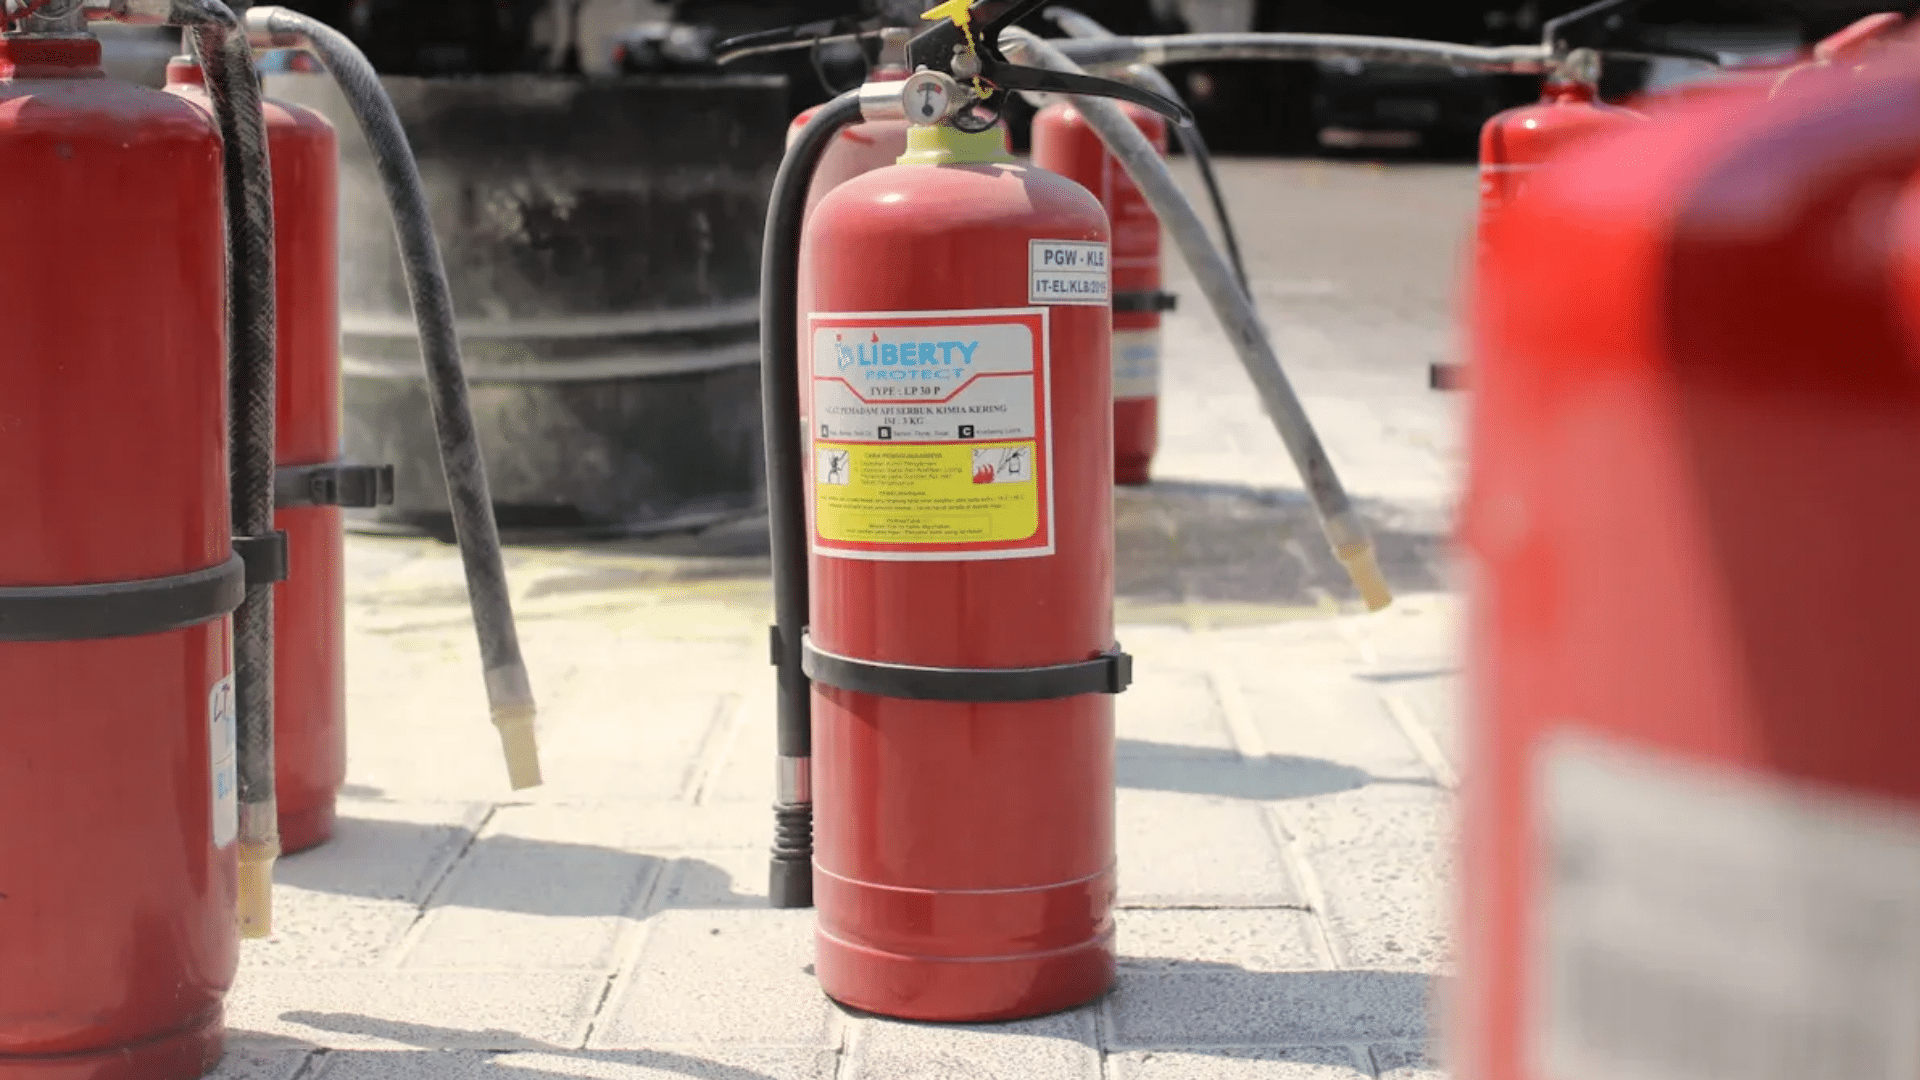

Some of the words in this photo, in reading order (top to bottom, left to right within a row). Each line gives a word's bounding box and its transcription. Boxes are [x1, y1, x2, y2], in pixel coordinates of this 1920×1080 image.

[1044, 249, 1077, 265] PGW
[857, 340, 979, 366] LIBERTY
[865, 368, 964, 380] PROTECT
[870, 386, 895, 396] TYPE
[904, 386, 918, 396] LP
[920, 386, 931, 395] 30
[934, 386, 940, 395] P
[880, 407, 894, 415] API
[896, 407, 934, 415] SERBUK
[936, 406, 967, 414] KIMIA
[968, 404, 1007, 413] KERING
